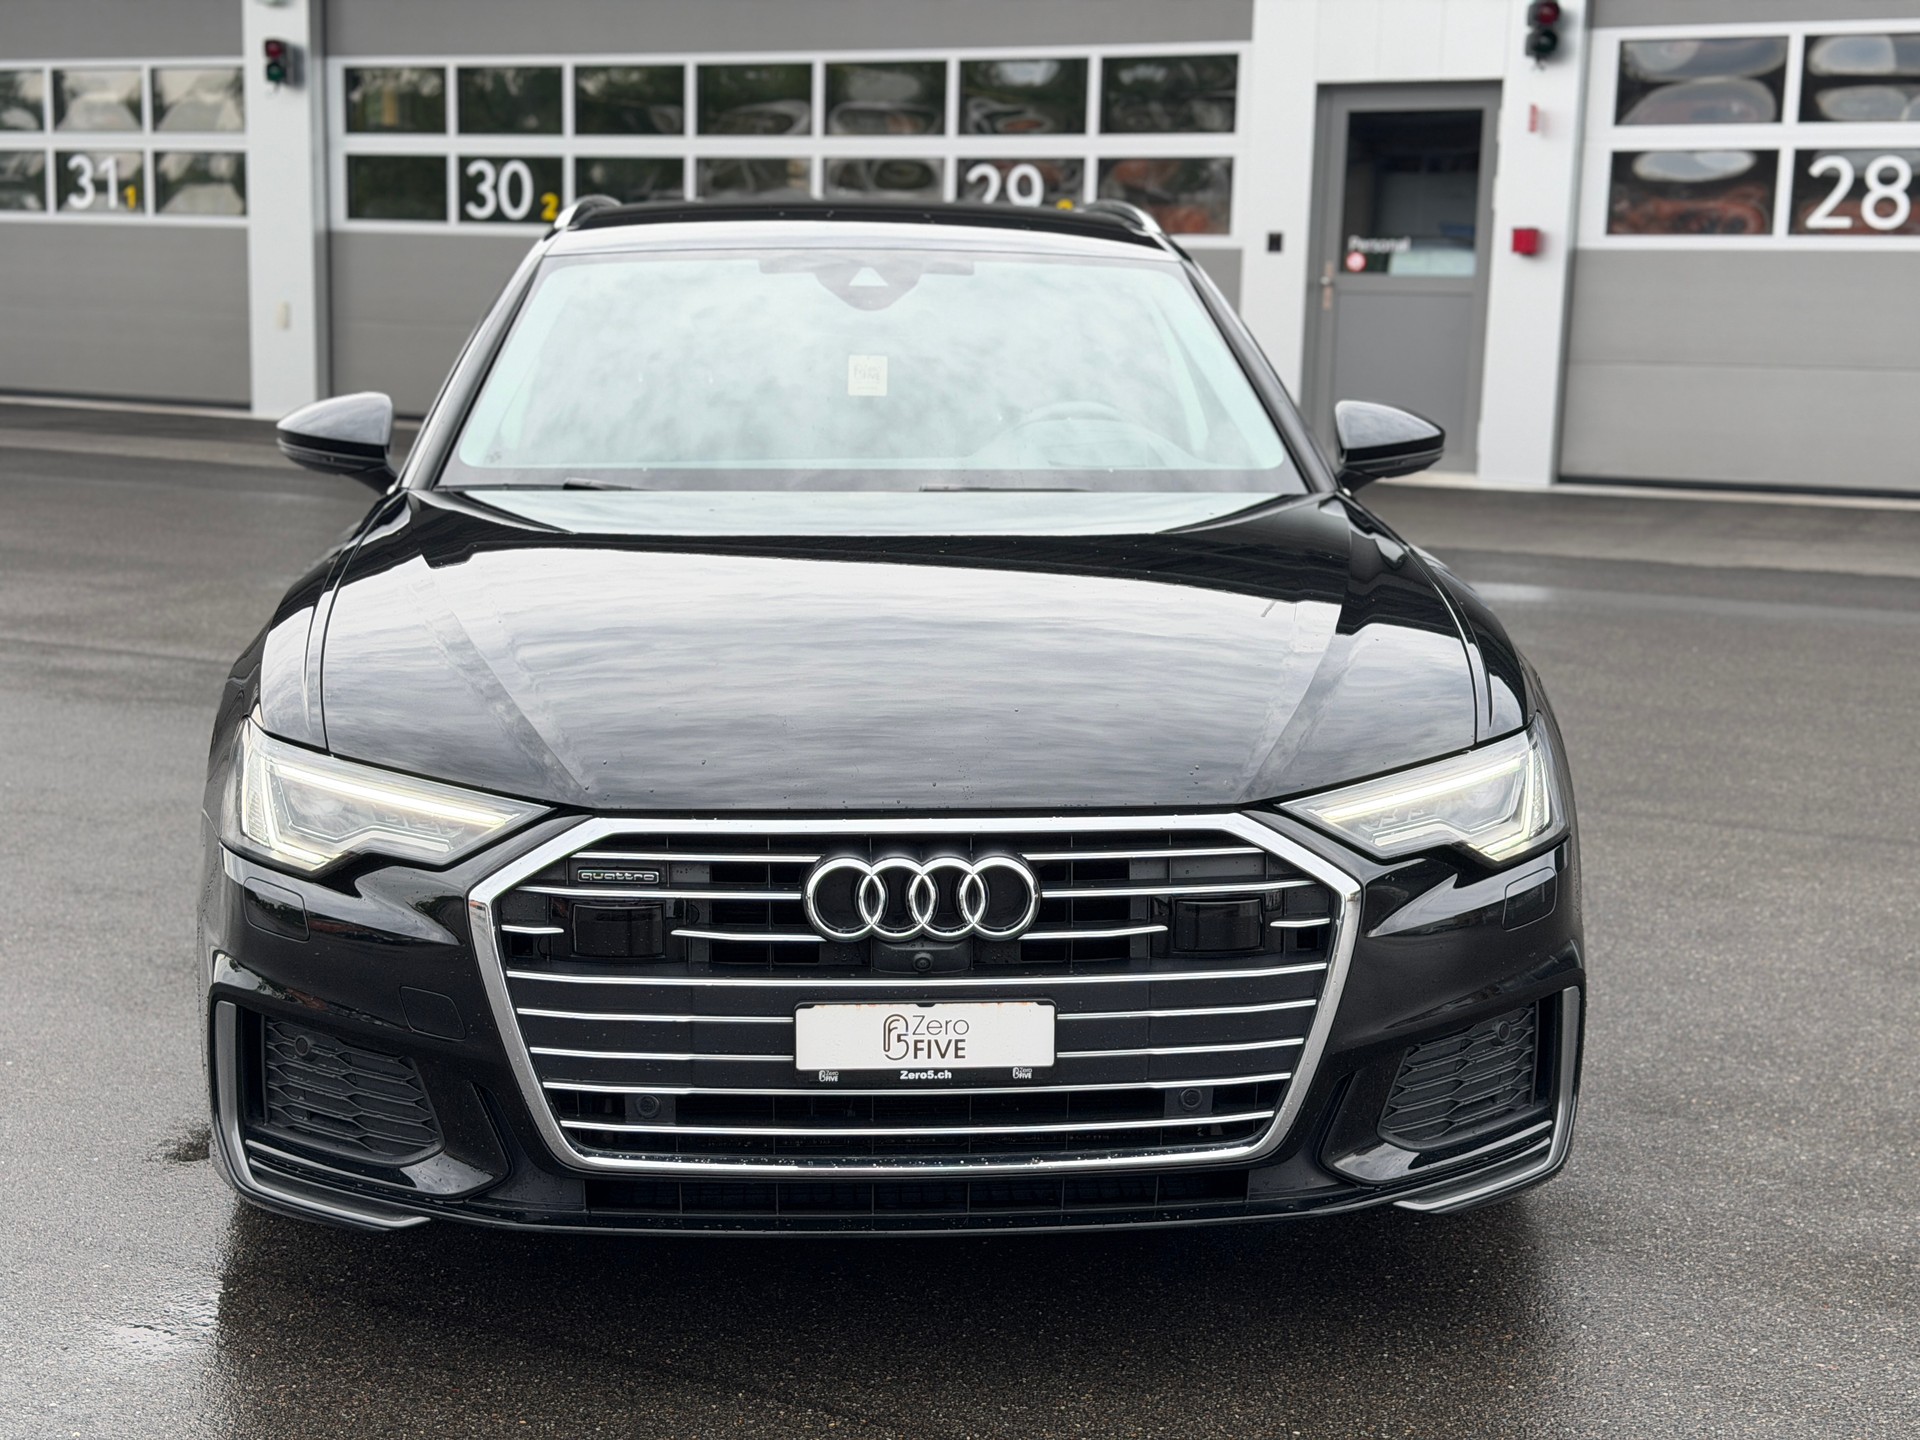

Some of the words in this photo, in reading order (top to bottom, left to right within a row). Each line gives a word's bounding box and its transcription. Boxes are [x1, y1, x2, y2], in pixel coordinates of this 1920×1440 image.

[67, 154, 119, 210] 31
[465, 158, 535, 221] 30
[1805, 154, 1913, 231] 28
[540, 192, 559, 221] 2
[581, 872, 655, 881] quattro
[912, 1014, 970, 1036] Zero
[913, 1038, 967, 1060] FIVE
[899, 1070, 952, 1080] Zero5.ch
